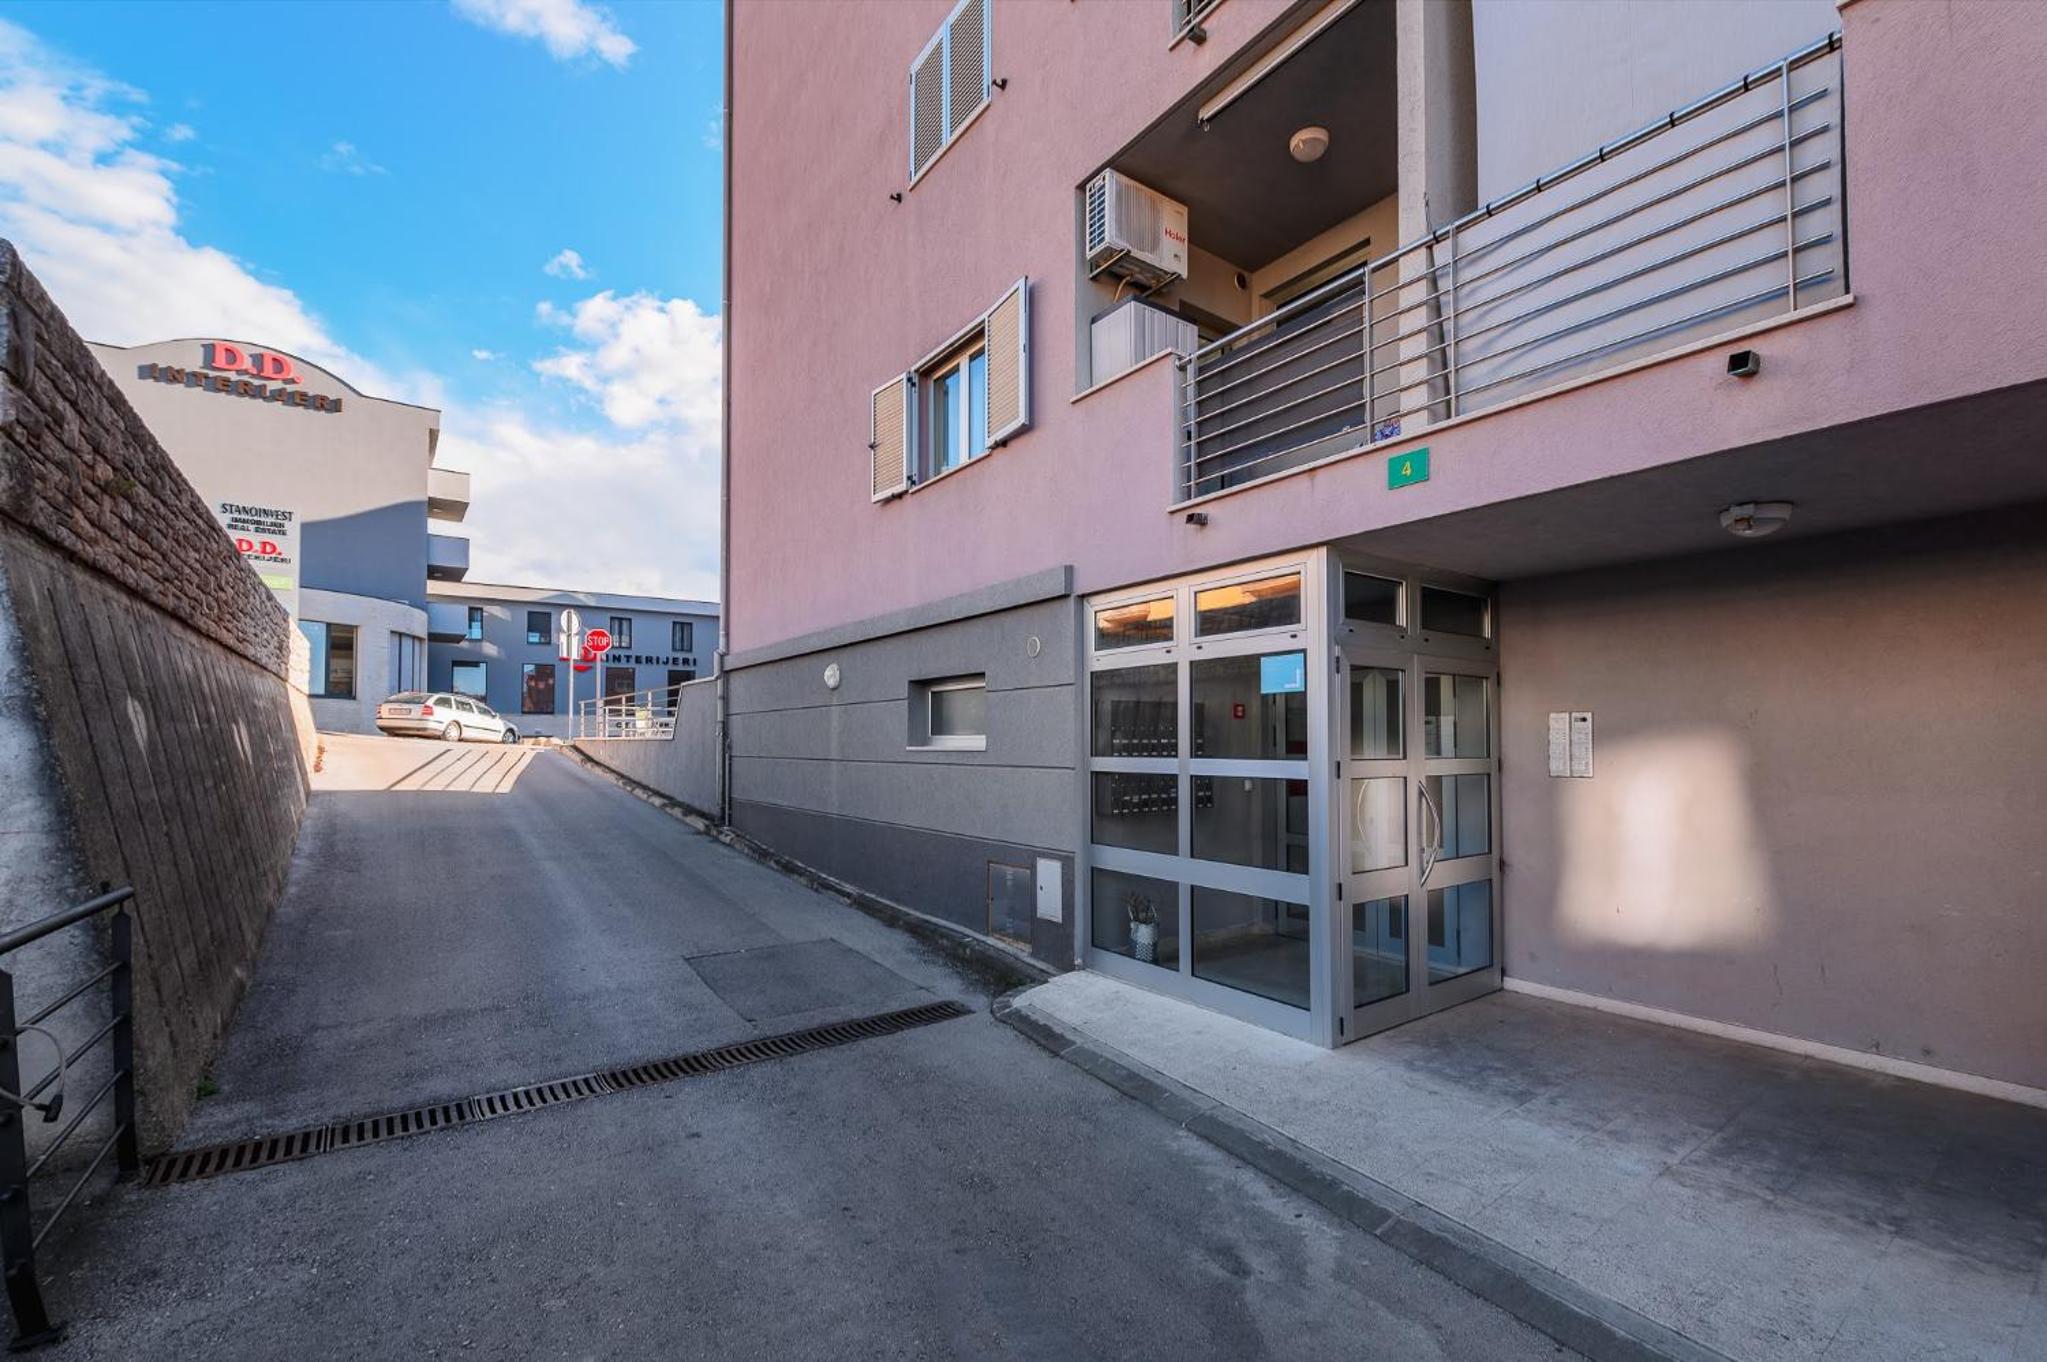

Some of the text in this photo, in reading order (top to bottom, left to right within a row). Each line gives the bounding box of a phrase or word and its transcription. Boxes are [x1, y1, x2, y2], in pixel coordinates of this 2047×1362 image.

[206, 341, 304, 385] D.D.
[147, 363, 343, 413] INTERIJERI
[1401, 460, 1412, 478] 4
[235, 538, 282, 556] D.D.
[586, 635, 611, 647] STOP
[605, 654, 697, 666] INTERIJERI
